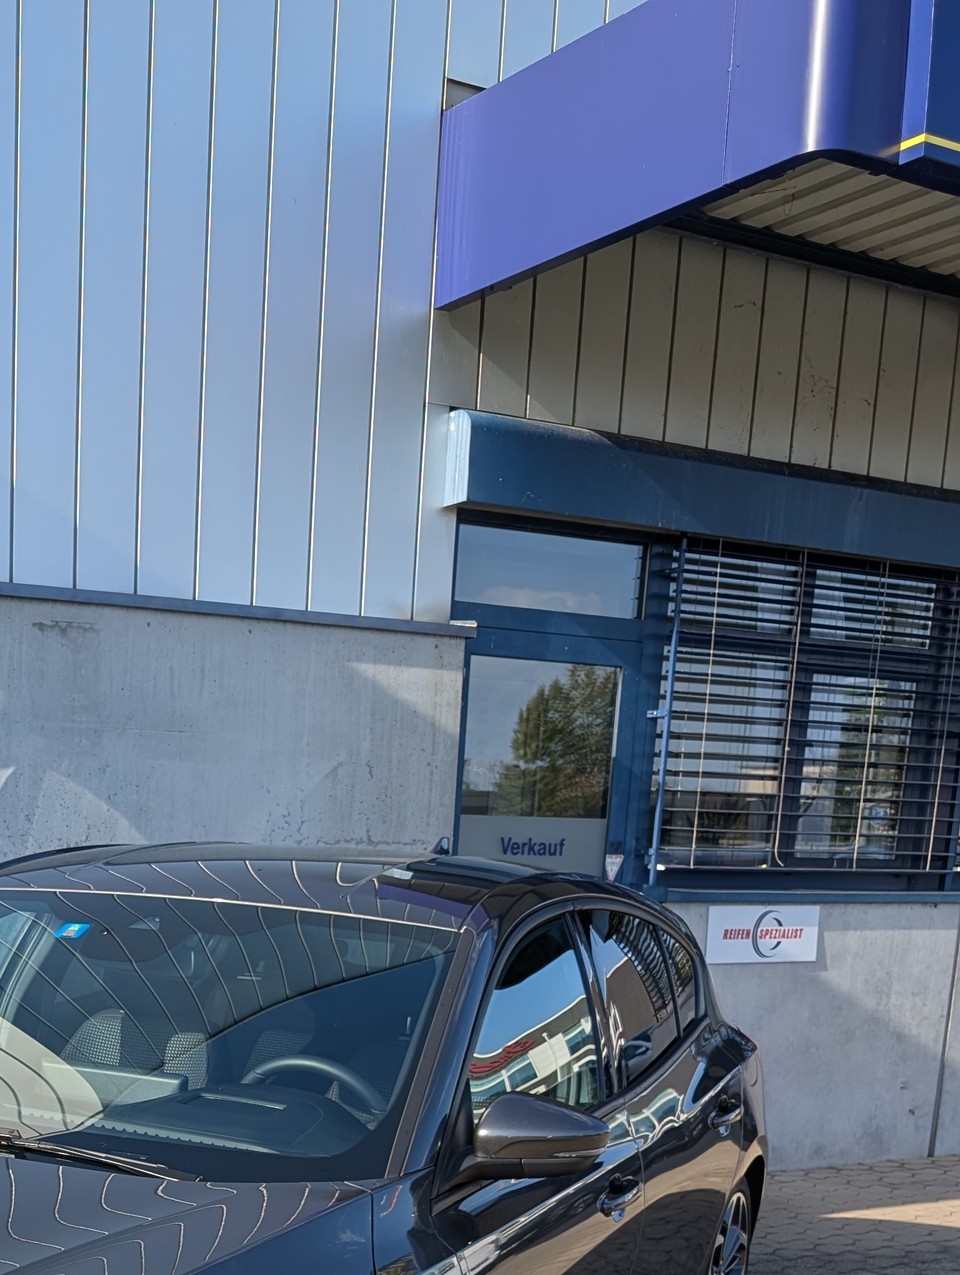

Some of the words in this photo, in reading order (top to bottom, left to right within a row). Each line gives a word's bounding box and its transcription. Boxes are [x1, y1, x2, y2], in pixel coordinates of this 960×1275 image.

[500, 837, 566, 856] Verkauf
[722, 928, 751, 940] REIFEN
[758, 928, 804, 940] SPEZIALIST
